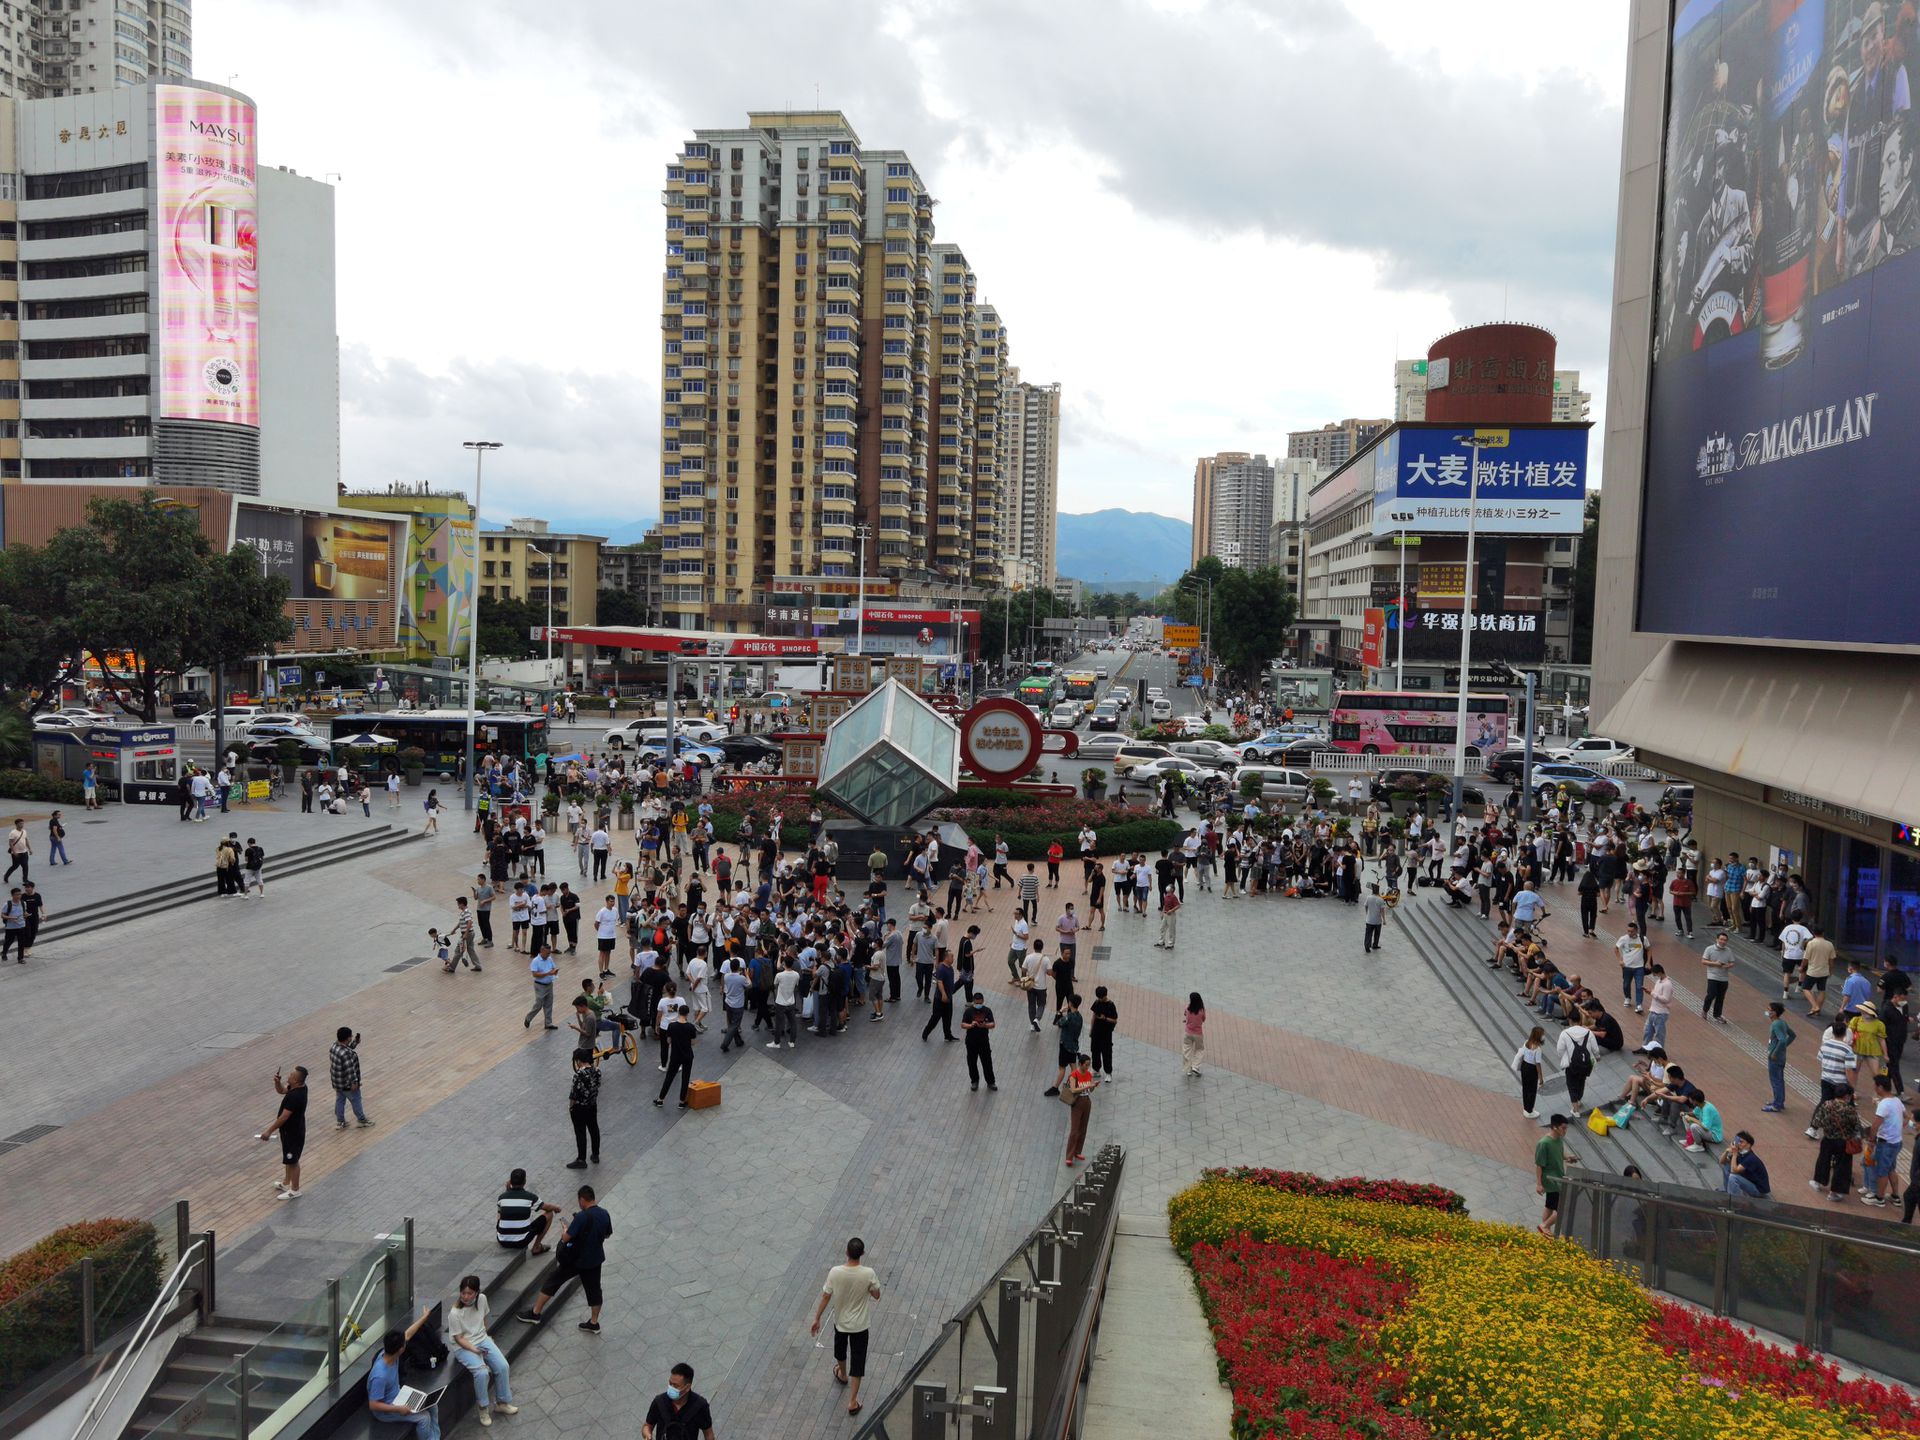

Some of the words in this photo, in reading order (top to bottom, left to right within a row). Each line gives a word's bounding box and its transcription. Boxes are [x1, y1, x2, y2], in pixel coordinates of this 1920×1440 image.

[189, 120, 246, 146] MAYSU
[1736, 429, 1763, 471] The
[1760, 392, 1875, 465] MACALLAN
[1406, 453, 1468, 487] 大麦
[1475, 460, 1578, 488] 微针植发
[1416, 506, 1561, 519] 种植孔比传统植发小三分之一
[767, 609, 800, 621] 华南通
[868, 611, 894, 619] 中国石化
[743, 642, 776, 652] 中国石化
[781, 645, 812, 653] SINOPEC
